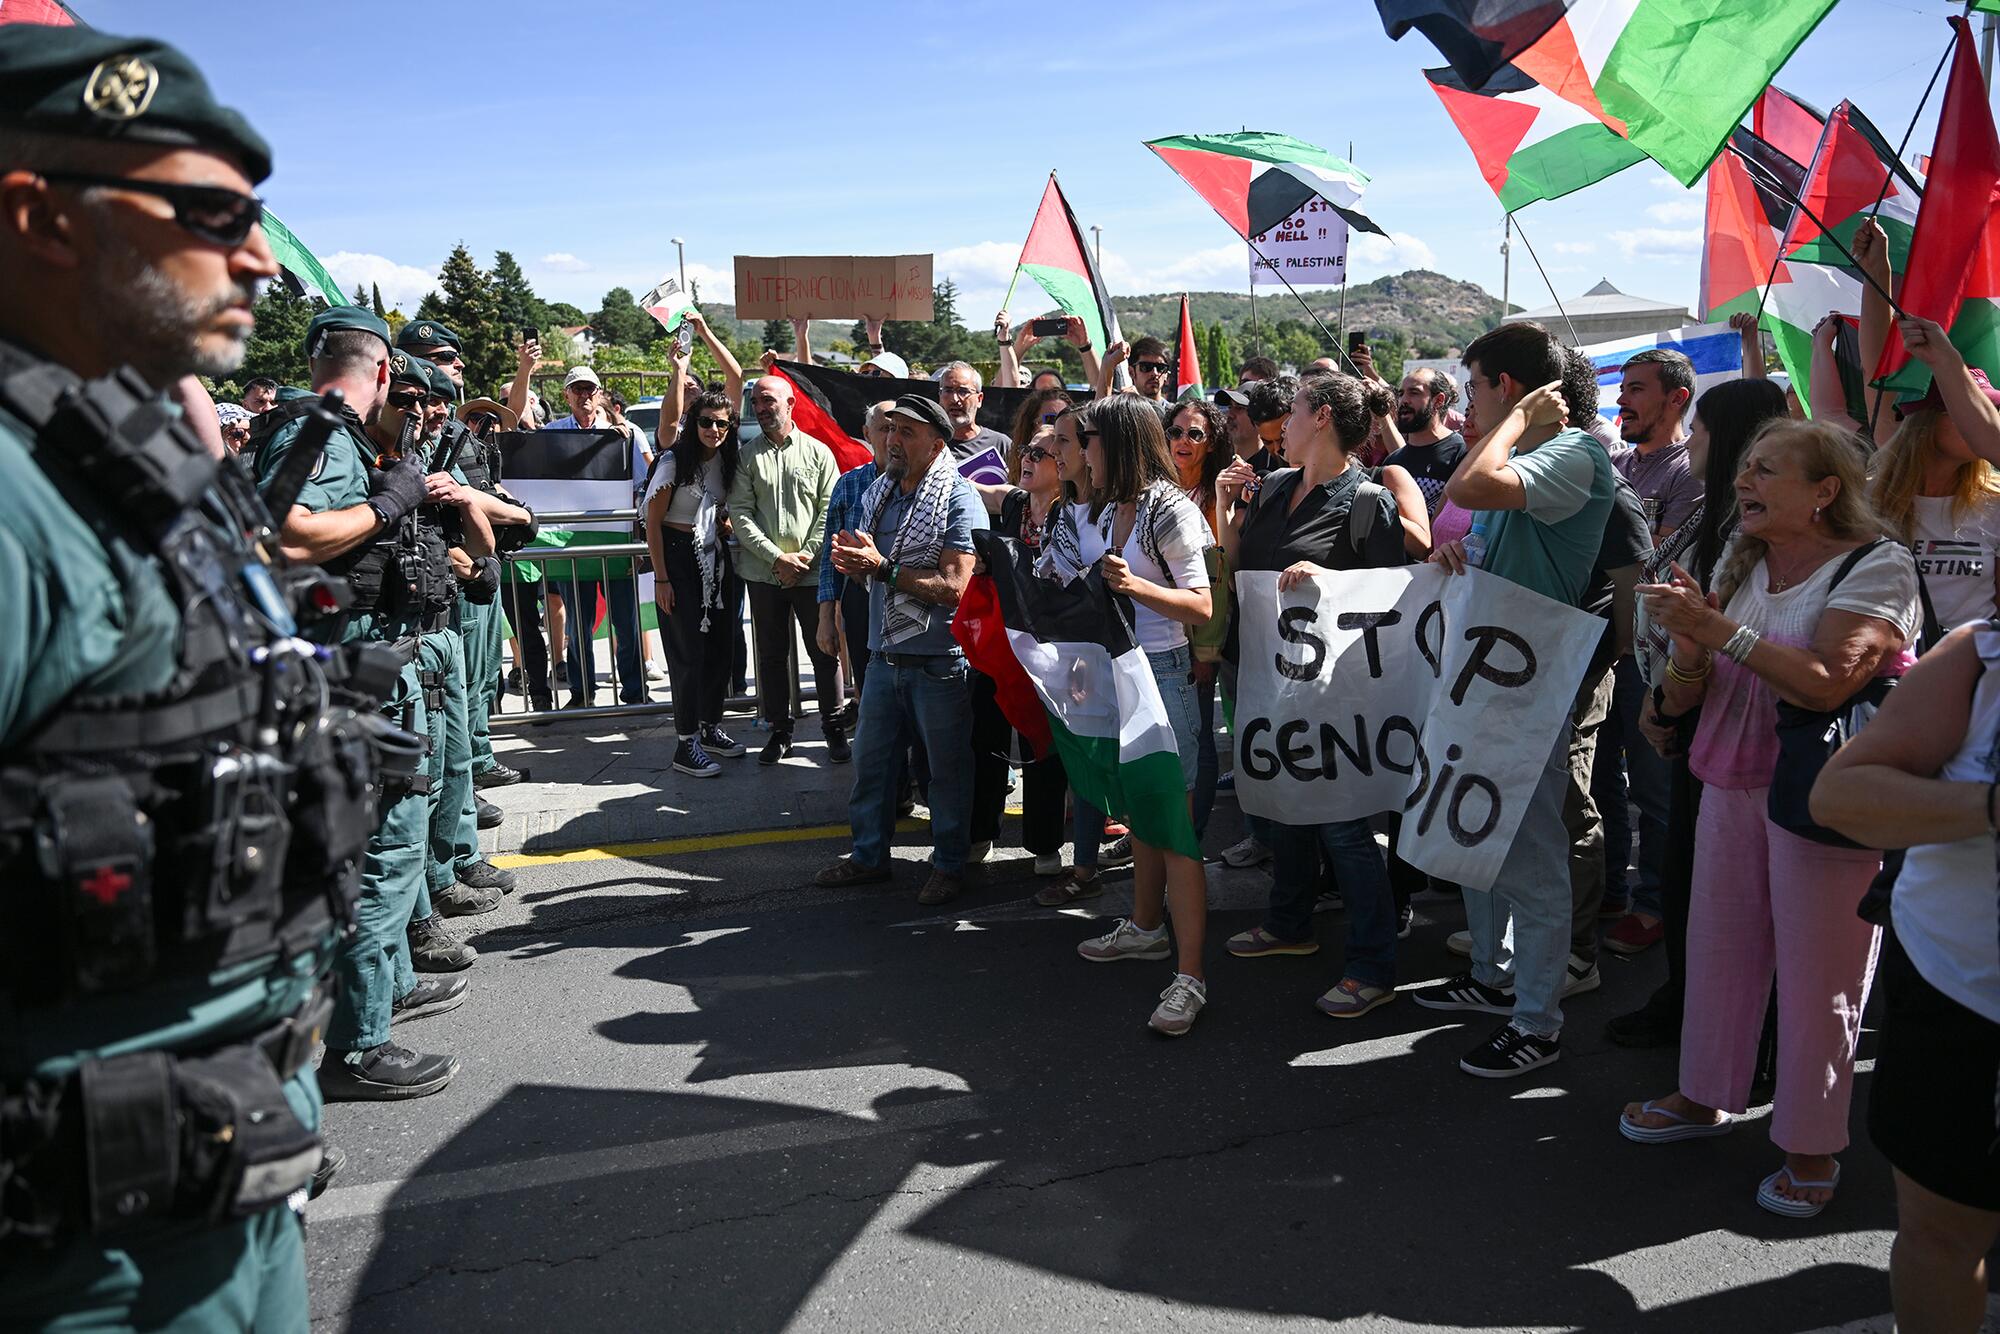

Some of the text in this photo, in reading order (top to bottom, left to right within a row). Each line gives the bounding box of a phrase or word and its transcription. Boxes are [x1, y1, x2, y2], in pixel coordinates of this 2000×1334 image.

[1282, 218, 1305, 230] GO
[1275, 230, 1309, 242] HELL
[1286, 256, 1343, 268] PALESTINE
[746, 270, 874, 303] INTERNACIONAL
[1275, 600, 1538, 706] STOP
